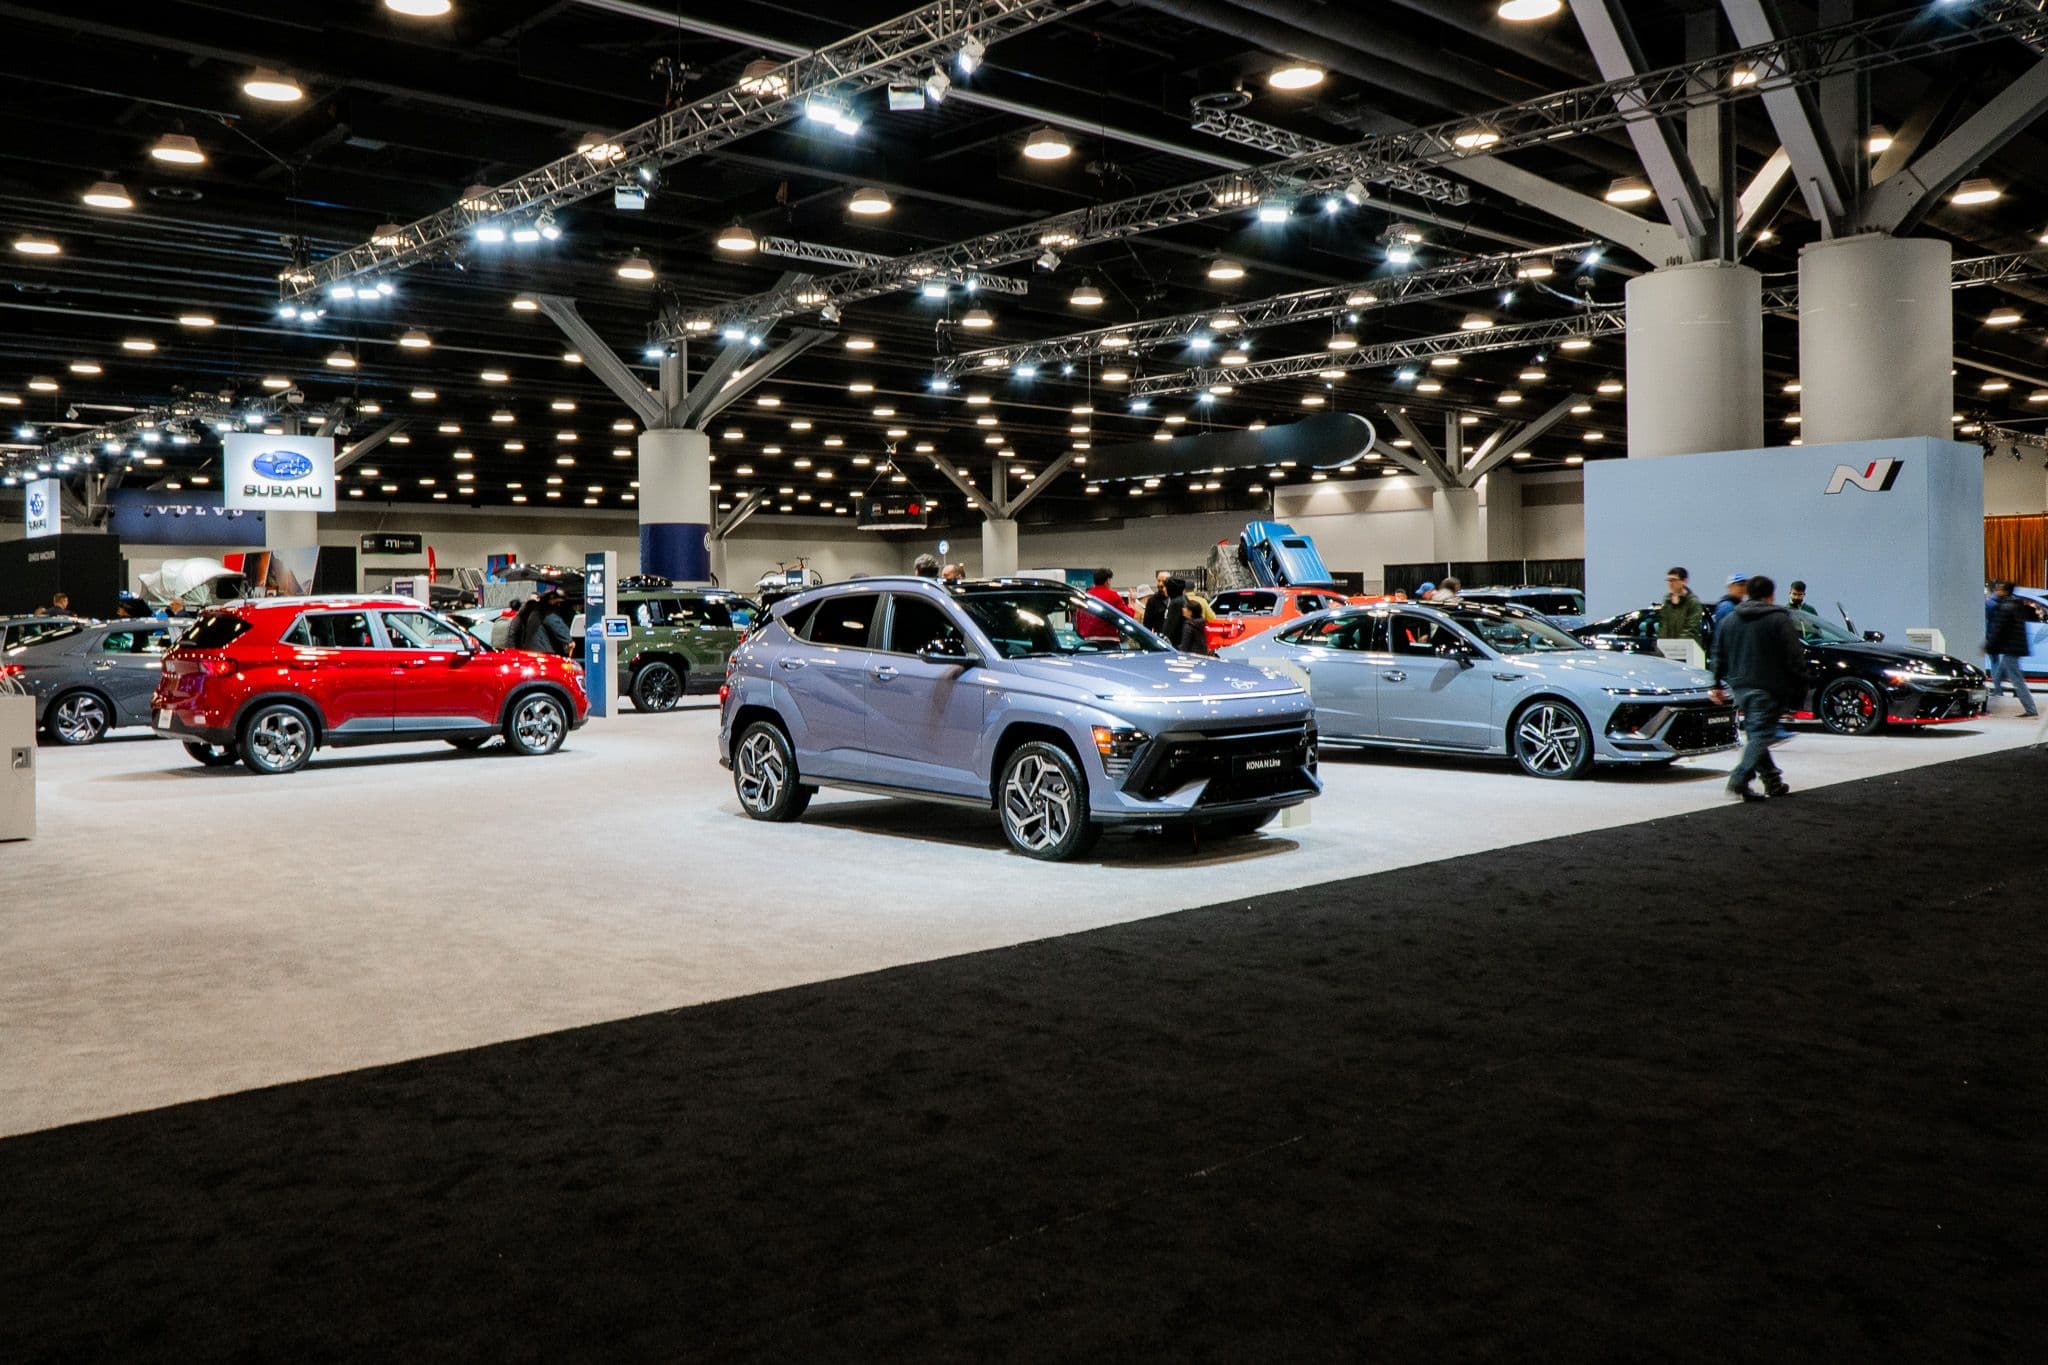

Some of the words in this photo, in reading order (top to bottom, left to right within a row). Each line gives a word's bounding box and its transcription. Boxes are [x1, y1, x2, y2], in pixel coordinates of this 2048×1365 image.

[243, 484, 322, 498] SUBARU
[1246, 759, 1264, 771] KONA
[1264, 759, 1269, 768] N
[1269, 758, 1281, 768] Line
